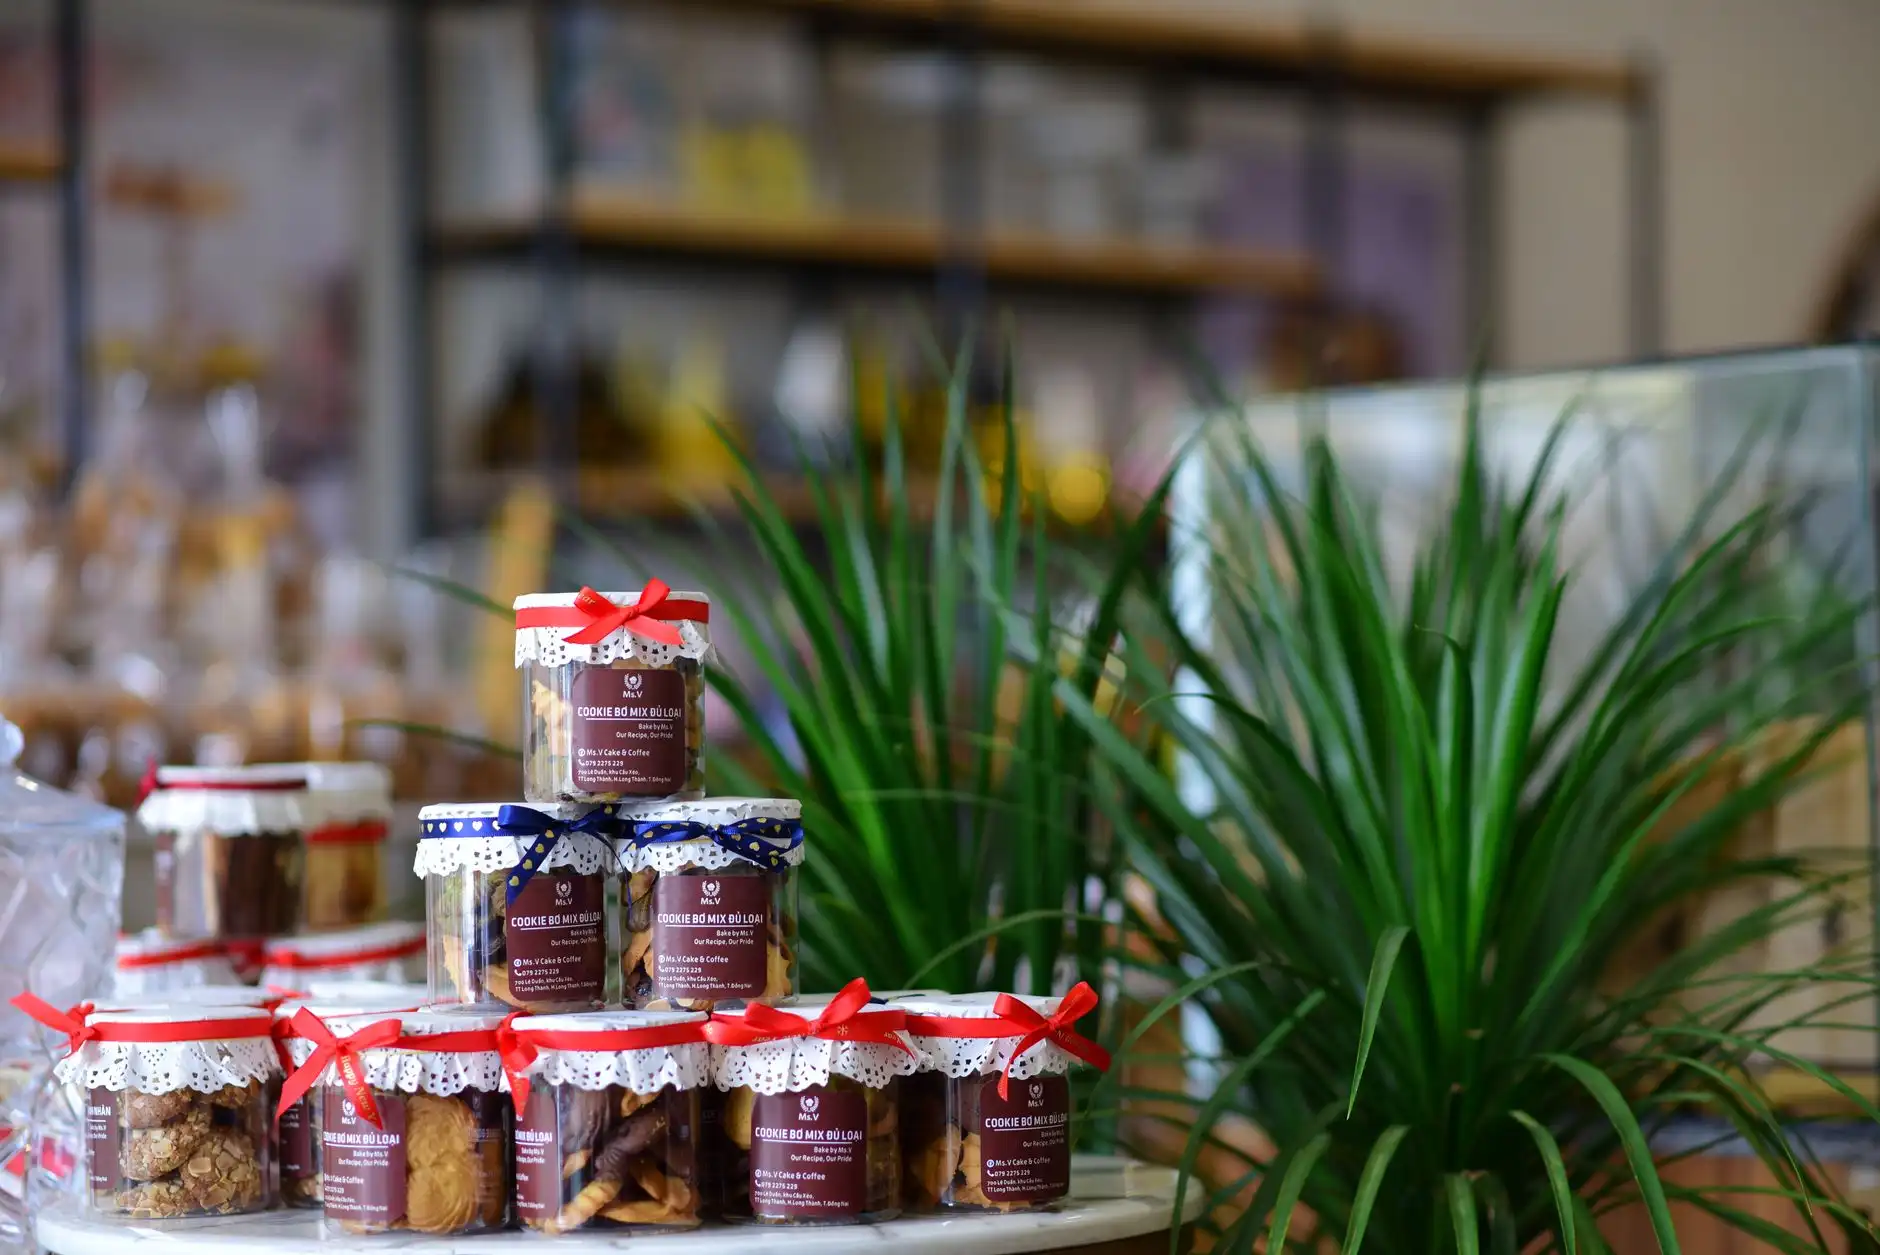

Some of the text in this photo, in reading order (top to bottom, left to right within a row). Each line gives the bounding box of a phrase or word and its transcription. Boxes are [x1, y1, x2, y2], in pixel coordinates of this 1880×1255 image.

[578, 706, 612, 716] COOKIE
[630, 708, 648, 717] MIX
[650, 705, 662, 717] ĐỦ
[664, 708, 682, 719] LOẠI
[654, 723, 660, 731] by
[628, 748, 650, 757] Coffee
[556, 898, 572, 906] Ms.V
[512, 916, 546, 927] COOKIE
[562, 914, 578, 924] MIX
[658, 914, 690, 924] COOKIE
[708, 914, 726, 924] MIX
[728, 911, 741, 924] ĐỦ
[744, 914, 763, 926] LOẠI
[342, 1055, 358, 1086] Happy
[356, 1086, 371, 1110] New
[985, 1117, 1020, 1128] COOKIE
[1034, 1115, 1048, 1126] MIX
[347, 1134, 361, 1144] MIX
[377, 1134, 400, 1146] LOẠI
[755, 1127, 788, 1139] COOKIE
[805, 1130, 824, 1140] MIX
[827, 1128, 840, 1140] ĐỦ
[842, 1130, 862, 1142] LOẠI
[802, 1172, 825, 1180] Coffee
